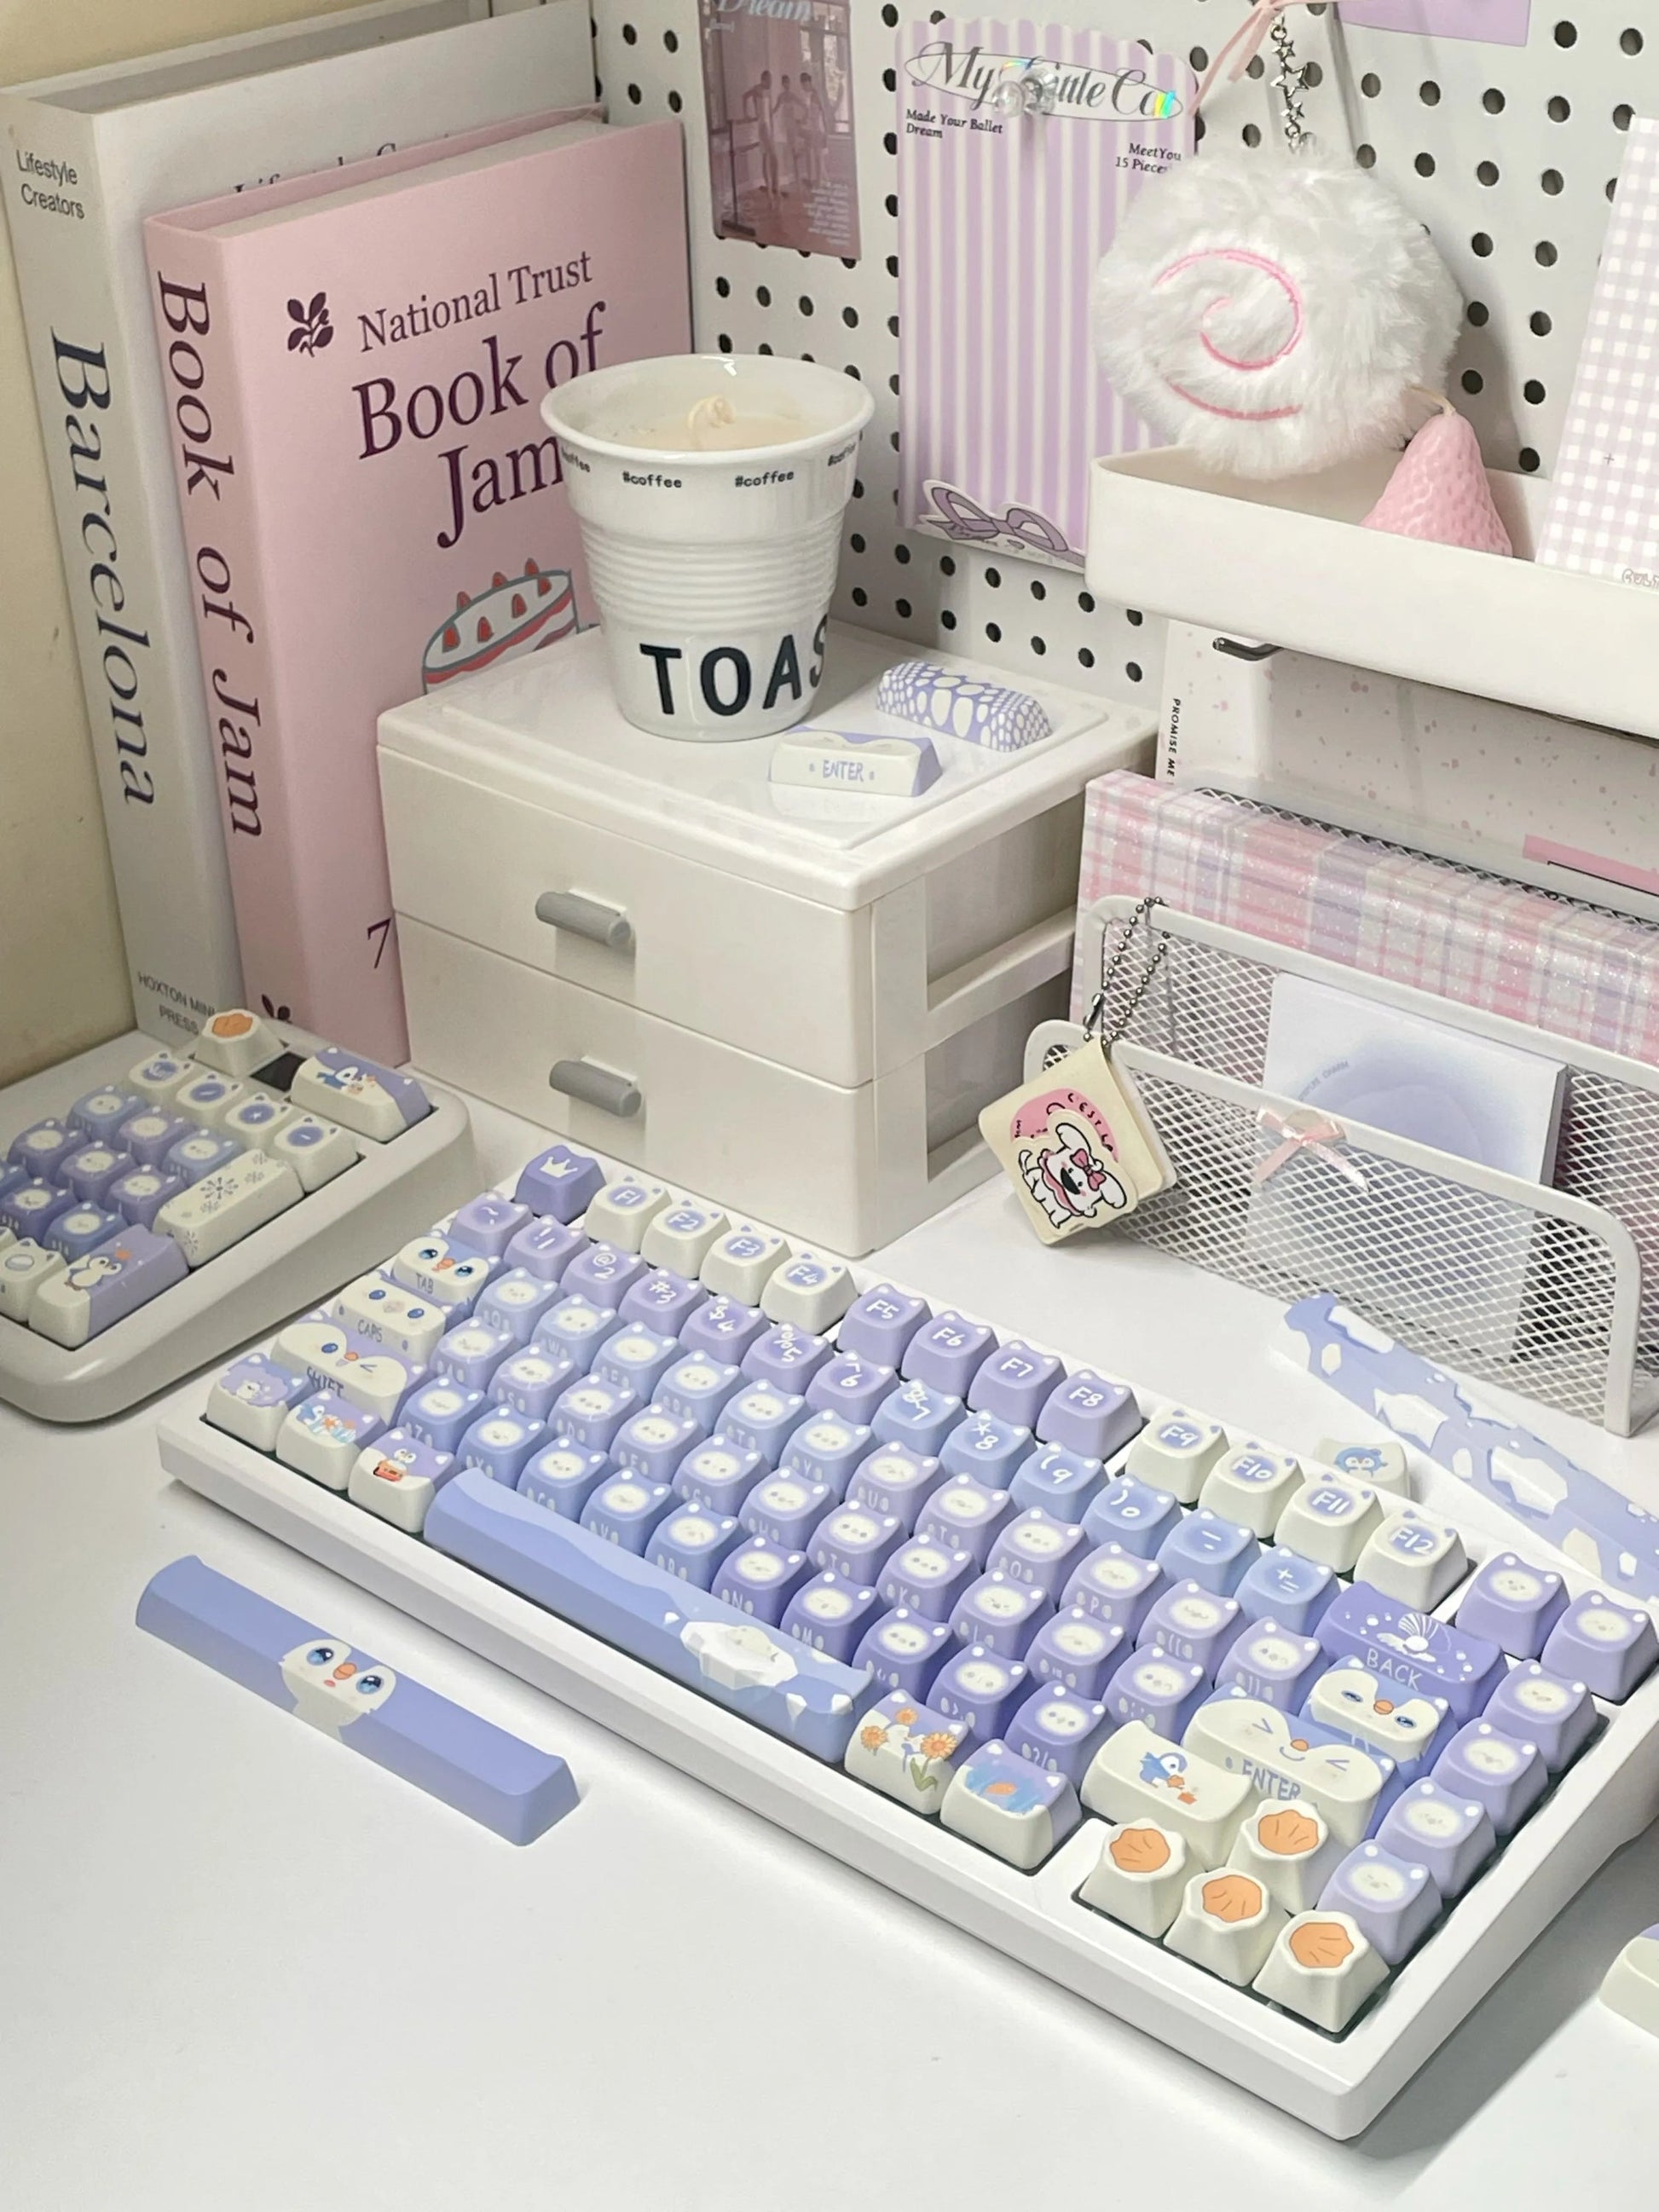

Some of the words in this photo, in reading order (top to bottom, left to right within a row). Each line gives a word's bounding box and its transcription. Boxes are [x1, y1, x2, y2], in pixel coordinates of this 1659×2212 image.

[911, 41, 995, 111] My
[906, 109, 936, 125] Made
[939, 113, 968, 129] Your
[969, 118, 1003, 135] Ballet
[906, 123, 943, 139] Dream
[1115, 156, 1130, 168] 15
[1128, 142, 1182, 162] MeetYou
[16, 148, 78, 188] Lifestyle
[20, 182, 85, 220] Creators
[358, 273, 503, 352] National
[506, 251, 593, 312] Trust
[157, 270, 235, 501] Book
[352, 334, 530, 459] Book
[544, 300, 607, 389] of
[622, 470, 683, 489] #coffee
[734, 469, 795, 488] #coffee
[436, 436, 564, 549] Jam
[49, 326, 155, 806] Barcelona
[195, 545, 256, 645] of
[1168, 697, 1182, 754] PROMISE
[211, 666, 263, 838] Jam
[823, 759, 865, 783] ENTER
[1166, 757, 1176, 777] ME
[137, 970, 188, 1008] HOXTON
[159, 1003, 199, 1037] PRESS
[615, 1188, 642, 1205] F1
[668, 1212, 700, 1231] F2
[730, 1238, 760, 1256] F3
[415, 1272, 435, 1295] TAB
[787, 1265, 818, 1285] F4
[865, 1299, 900, 1320] F5
[356, 1319, 383, 1343] CAPS
[932, 1326, 965, 1347] F6
[999, 1356, 1034, 1377] F7
[1068, 1385, 1105, 1407] F8
[1159, 1424, 1199, 1447] F9
[1231, 1457, 1272, 1480] F10
[1310, 1491, 1352, 1516] F11
[1389, 1526, 1436, 1556] F12
[1366, 1647, 1424, 1692] BACK
[1241, 1759, 1302, 1801] ENTER
